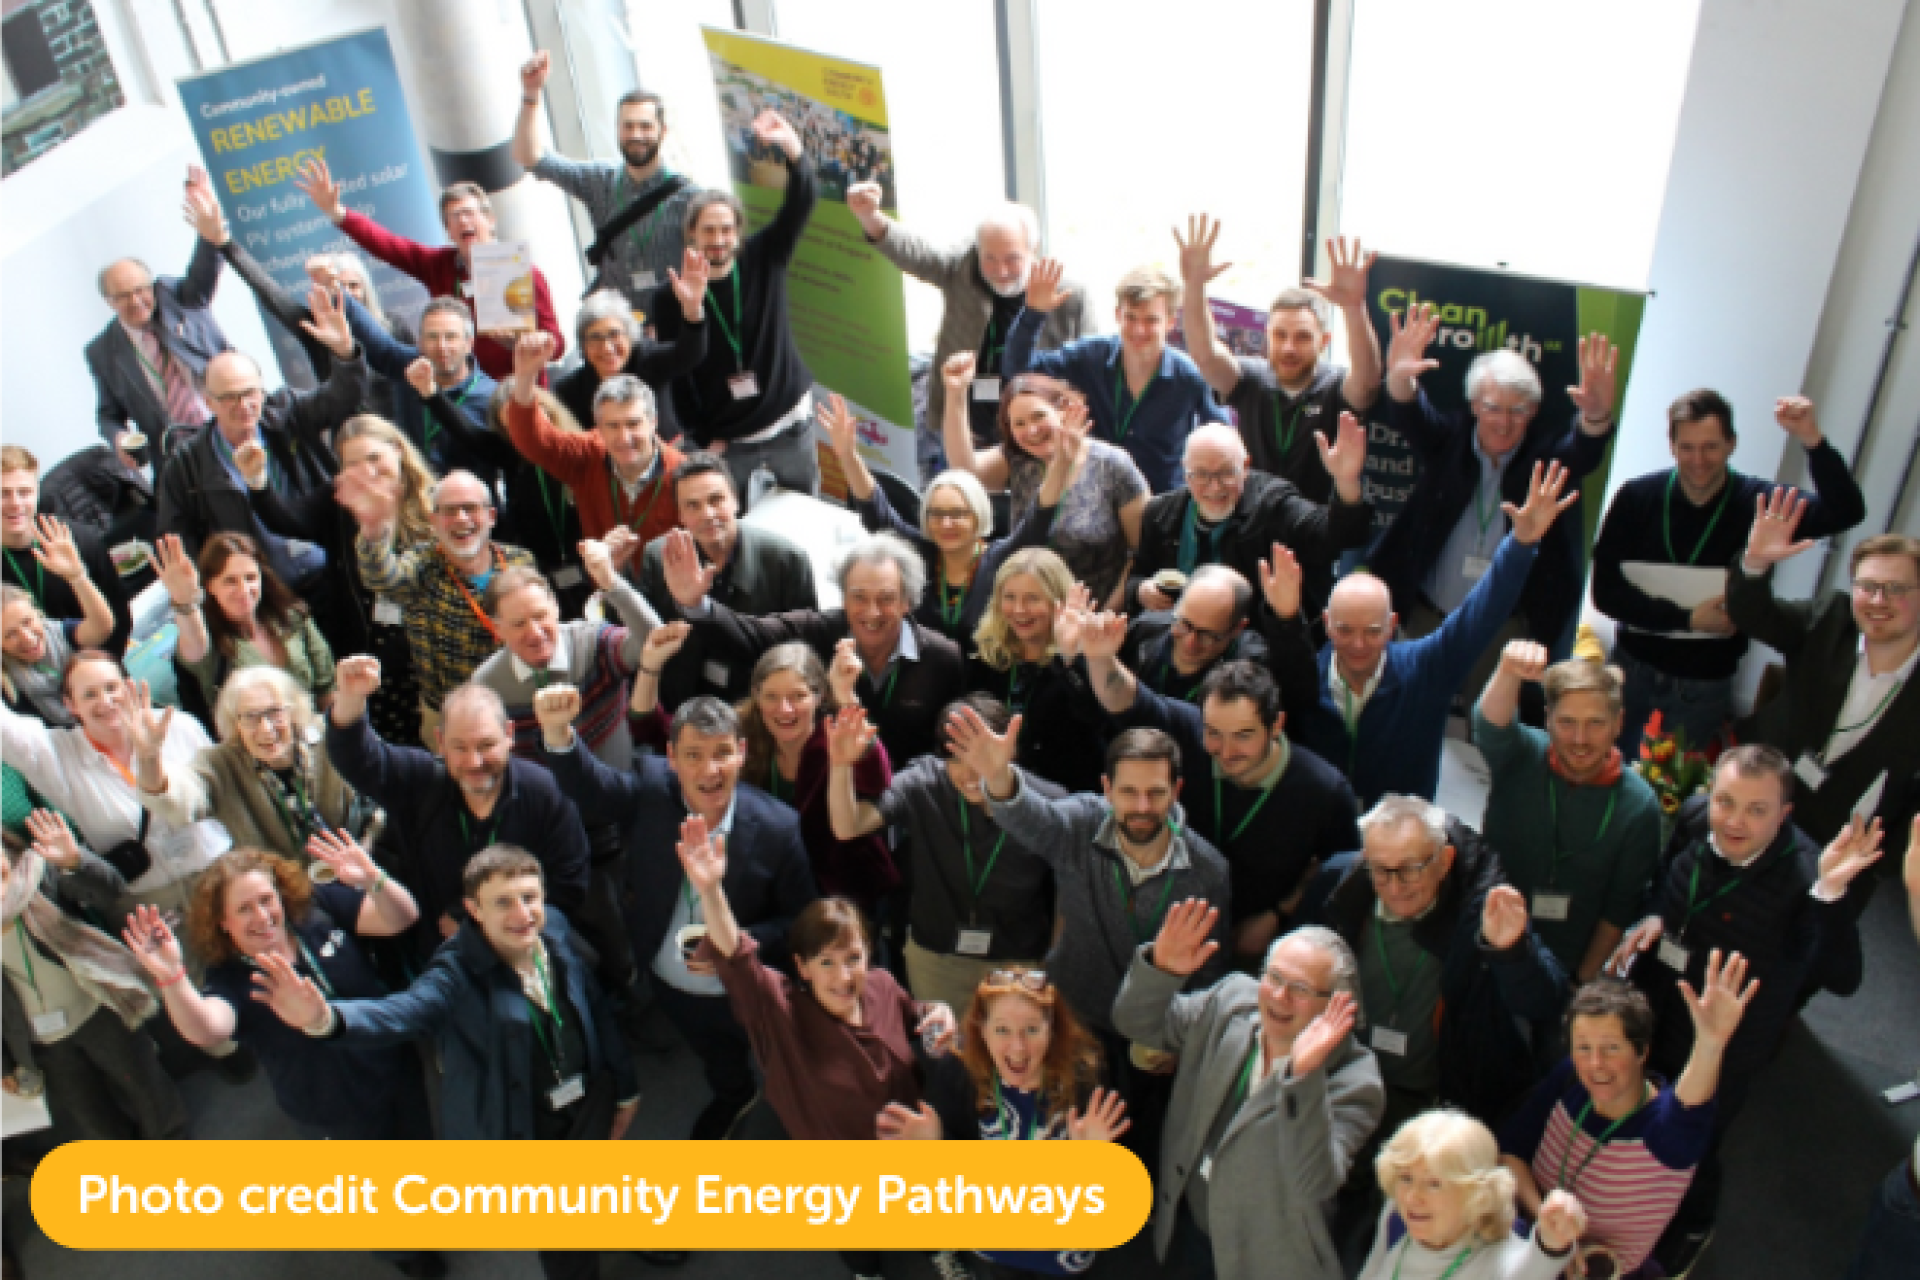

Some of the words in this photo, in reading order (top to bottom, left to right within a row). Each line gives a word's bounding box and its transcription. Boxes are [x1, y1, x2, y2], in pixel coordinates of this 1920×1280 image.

[209, 87, 377, 154] RENEWABLE
[237, 203, 268, 222] Our
[371, 163, 408, 185] solar
[275, 216, 331, 243] system
